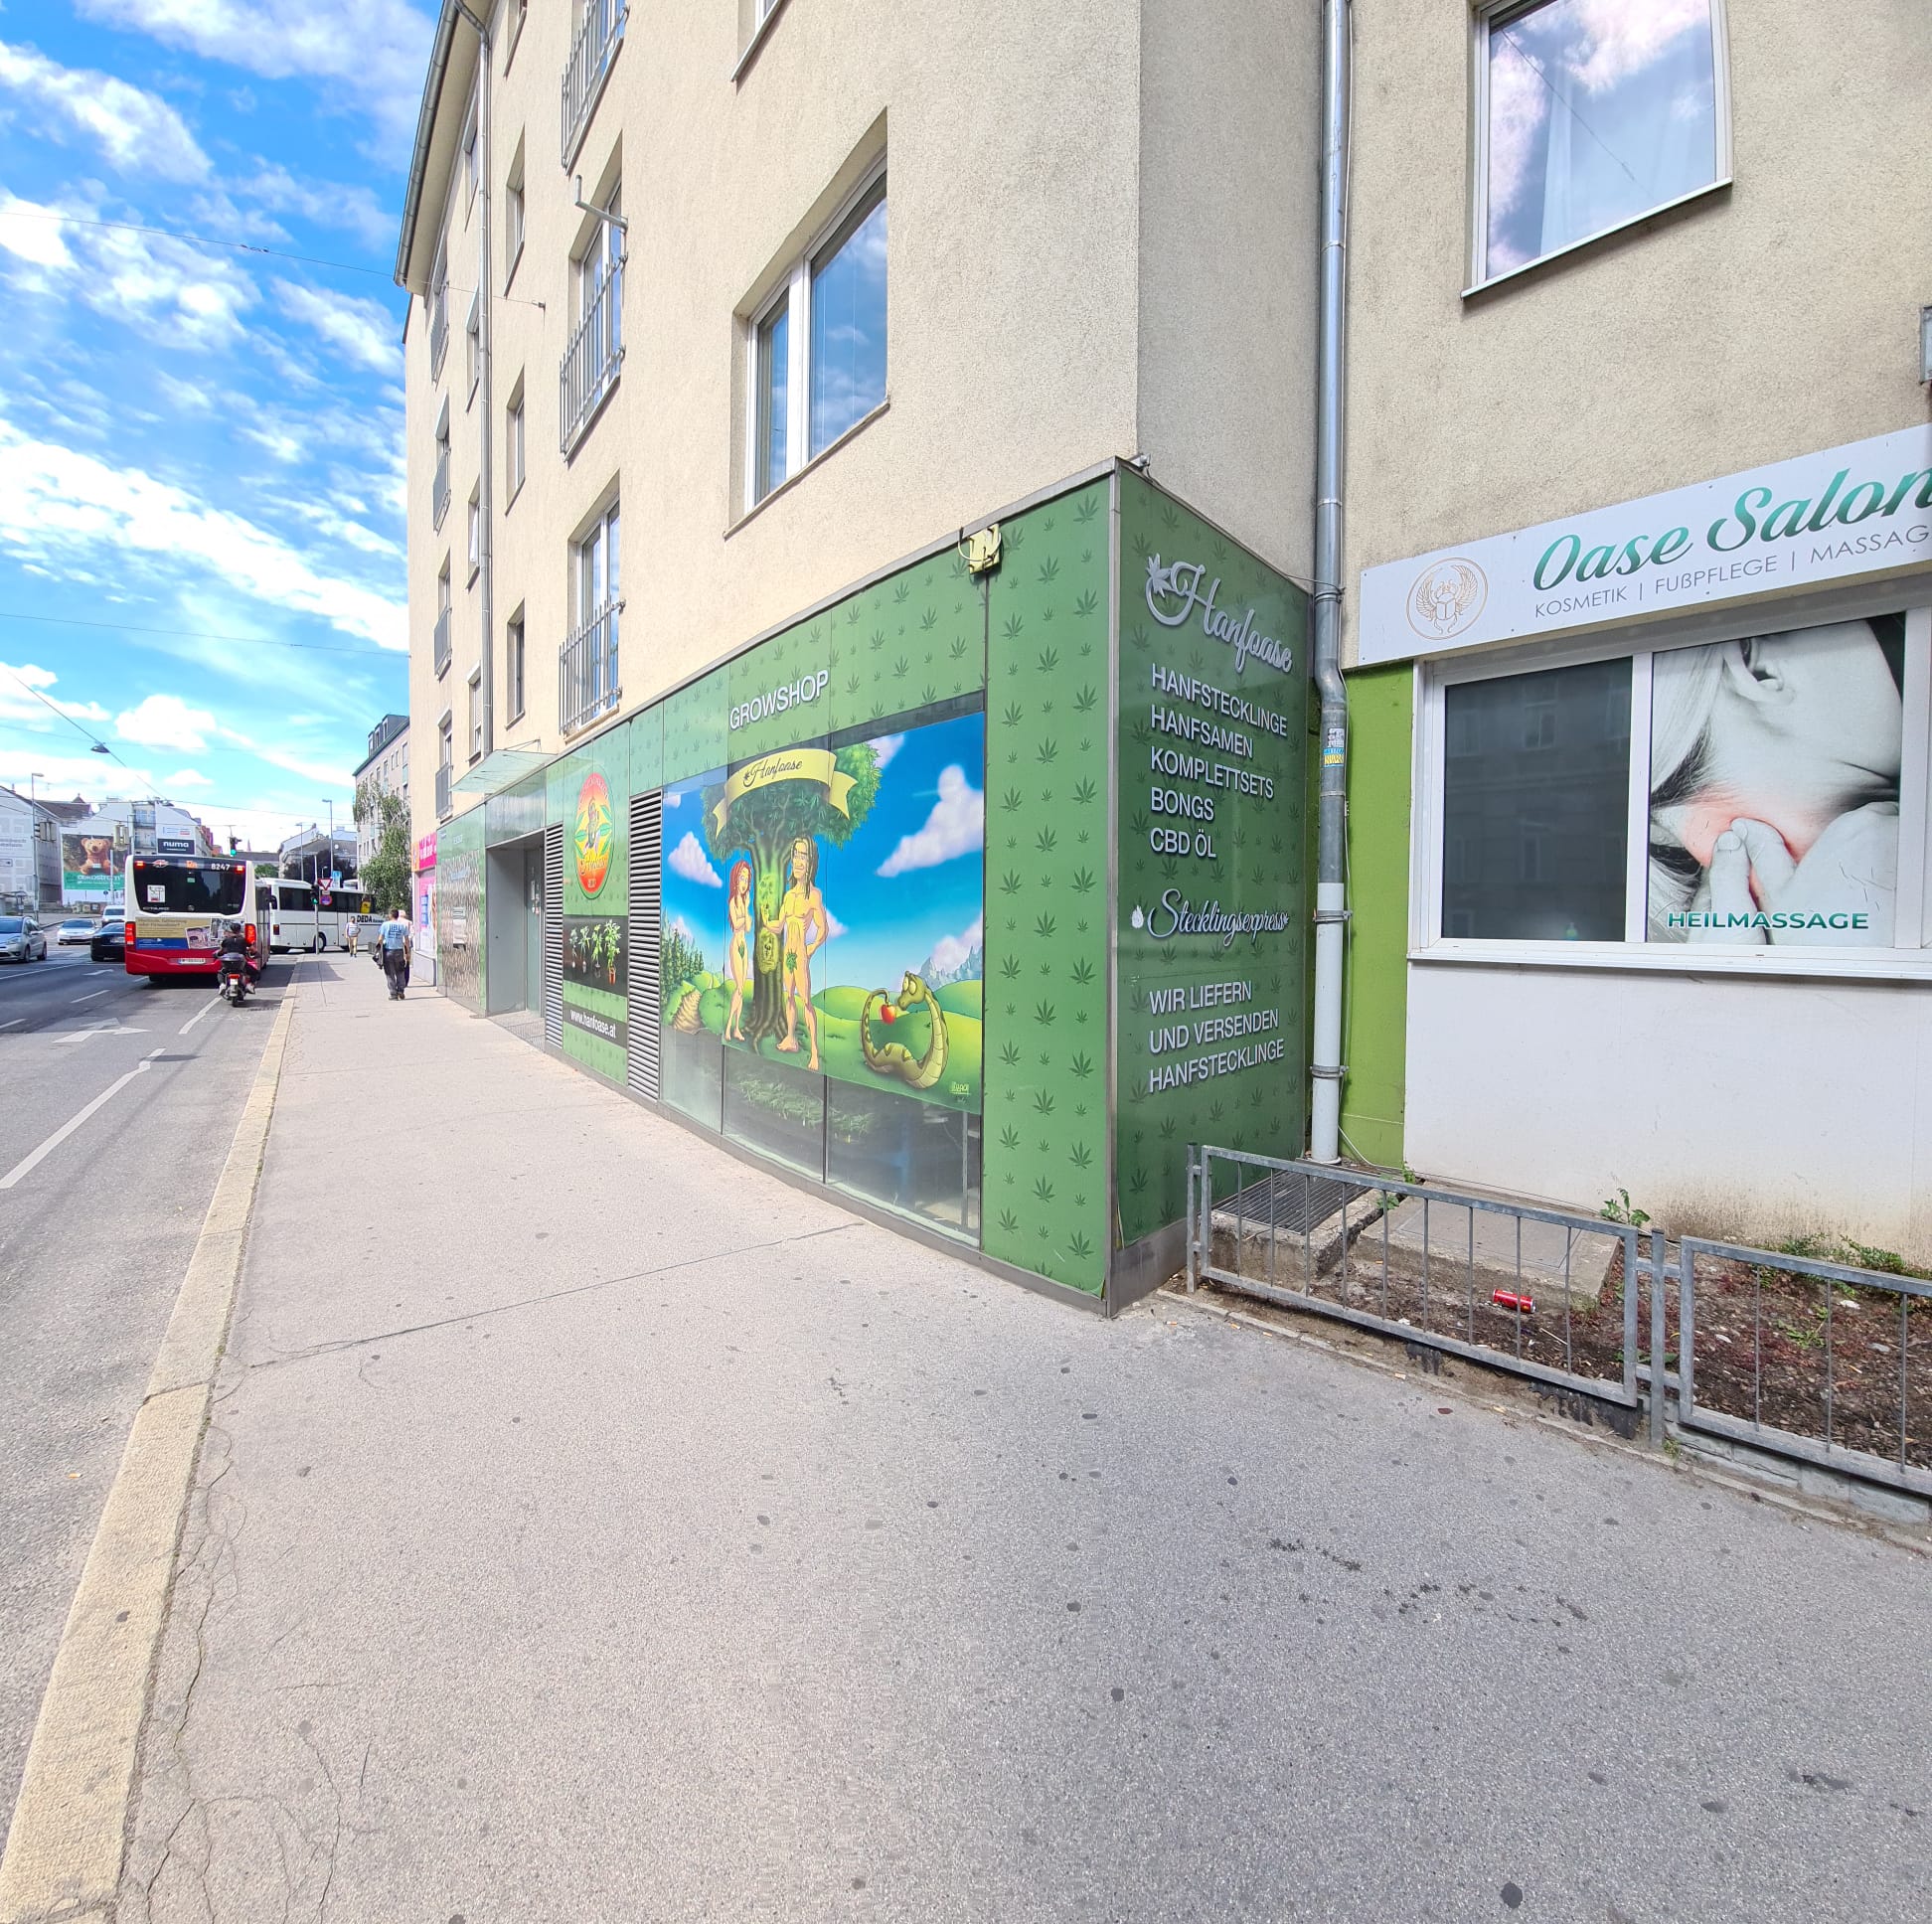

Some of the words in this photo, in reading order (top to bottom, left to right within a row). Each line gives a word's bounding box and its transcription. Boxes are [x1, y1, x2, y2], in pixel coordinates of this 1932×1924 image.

[1532, 527, 1693, 591] Oase
[1706, 467, 1932, 553] Salon
[1534, 586, 1628, 618] KOSMETIK
[1655, 556, 1777, 595] FUßPFLEGE
[1146, 560, 1292, 674] Hanfoase
[729, 669, 829, 729] GROWSHOP
[1151, 663, 1288, 736] HANFSTECKLINGE
[1151, 705, 1253, 758] HANFSAMEN
[1151, 746, 1274, 799] KOMPLETTSETS
[1151, 787, 1214, 821] BONGS
[1150, 828, 1191, 855] CBD
[1195, 829, 1216, 858] ÖL
[1147, 888, 1286, 946] Stecklingsexpress
[1668, 912, 1869, 929] HEILMASSAGE
[1149, 989, 1186, 1015] WIR
[1190, 981, 1252, 1010] LIEFERN
[1150, 1025, 1190, 1053] UND
[1194, 1009, 1279, 1044] VERSENDEN
[1149, 1039, 1285, 1093] HANFSTECKLINGE
